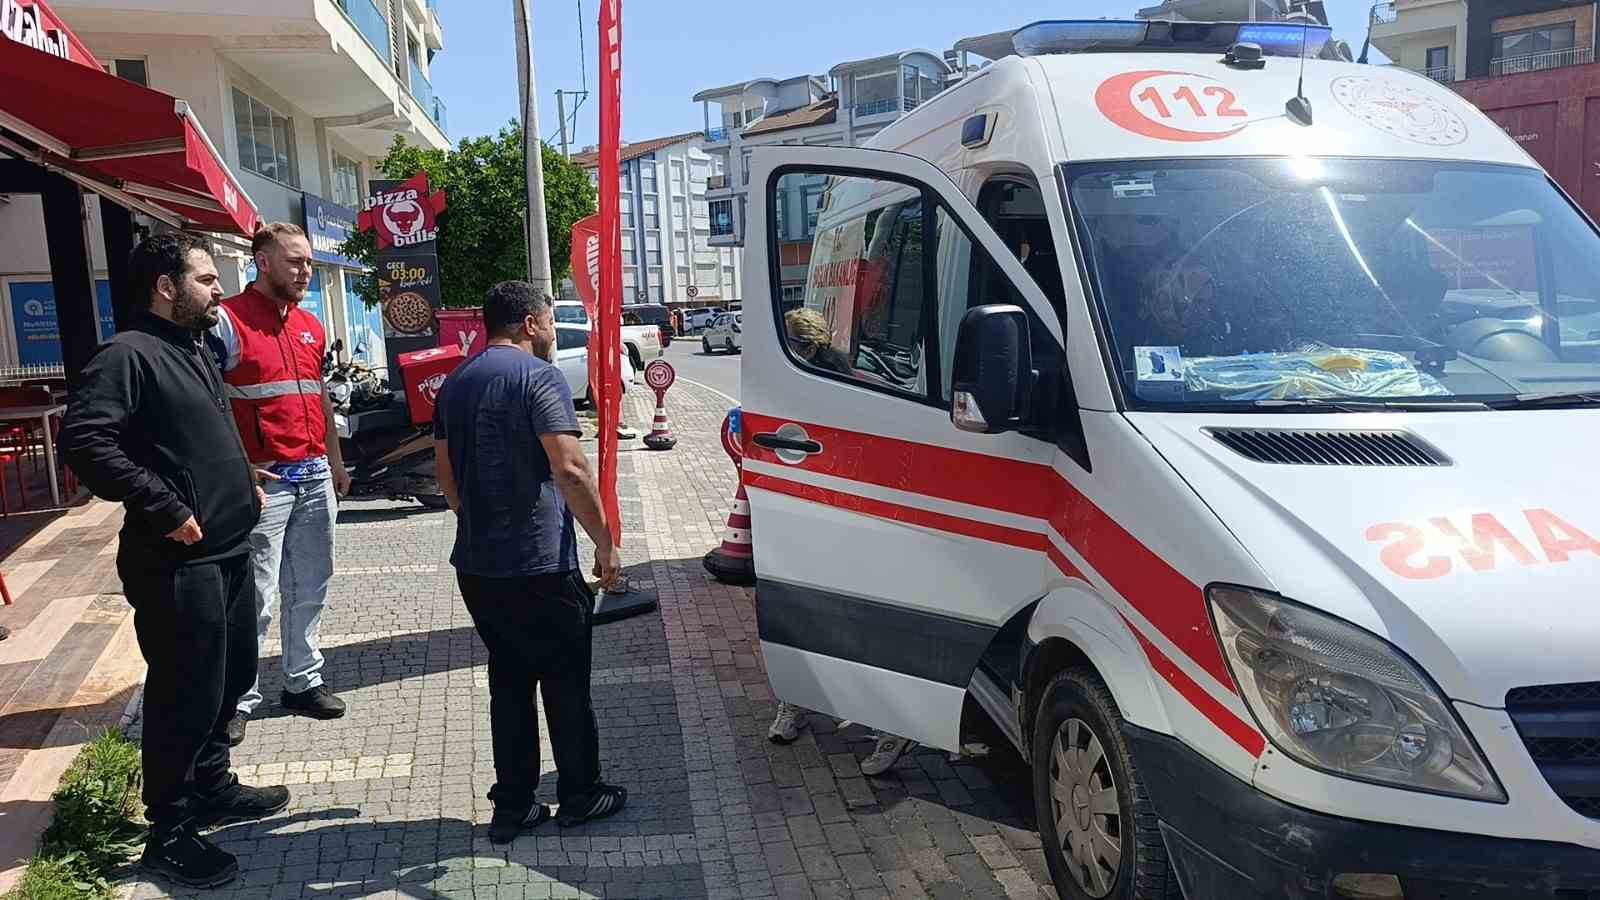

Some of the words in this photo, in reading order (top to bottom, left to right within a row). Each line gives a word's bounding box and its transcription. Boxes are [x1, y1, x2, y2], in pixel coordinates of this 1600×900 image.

[1137, 85, 1248, 118] 112
[363, 188, 418, 211] pizza
[391, 267, 425, 280] 03:00
